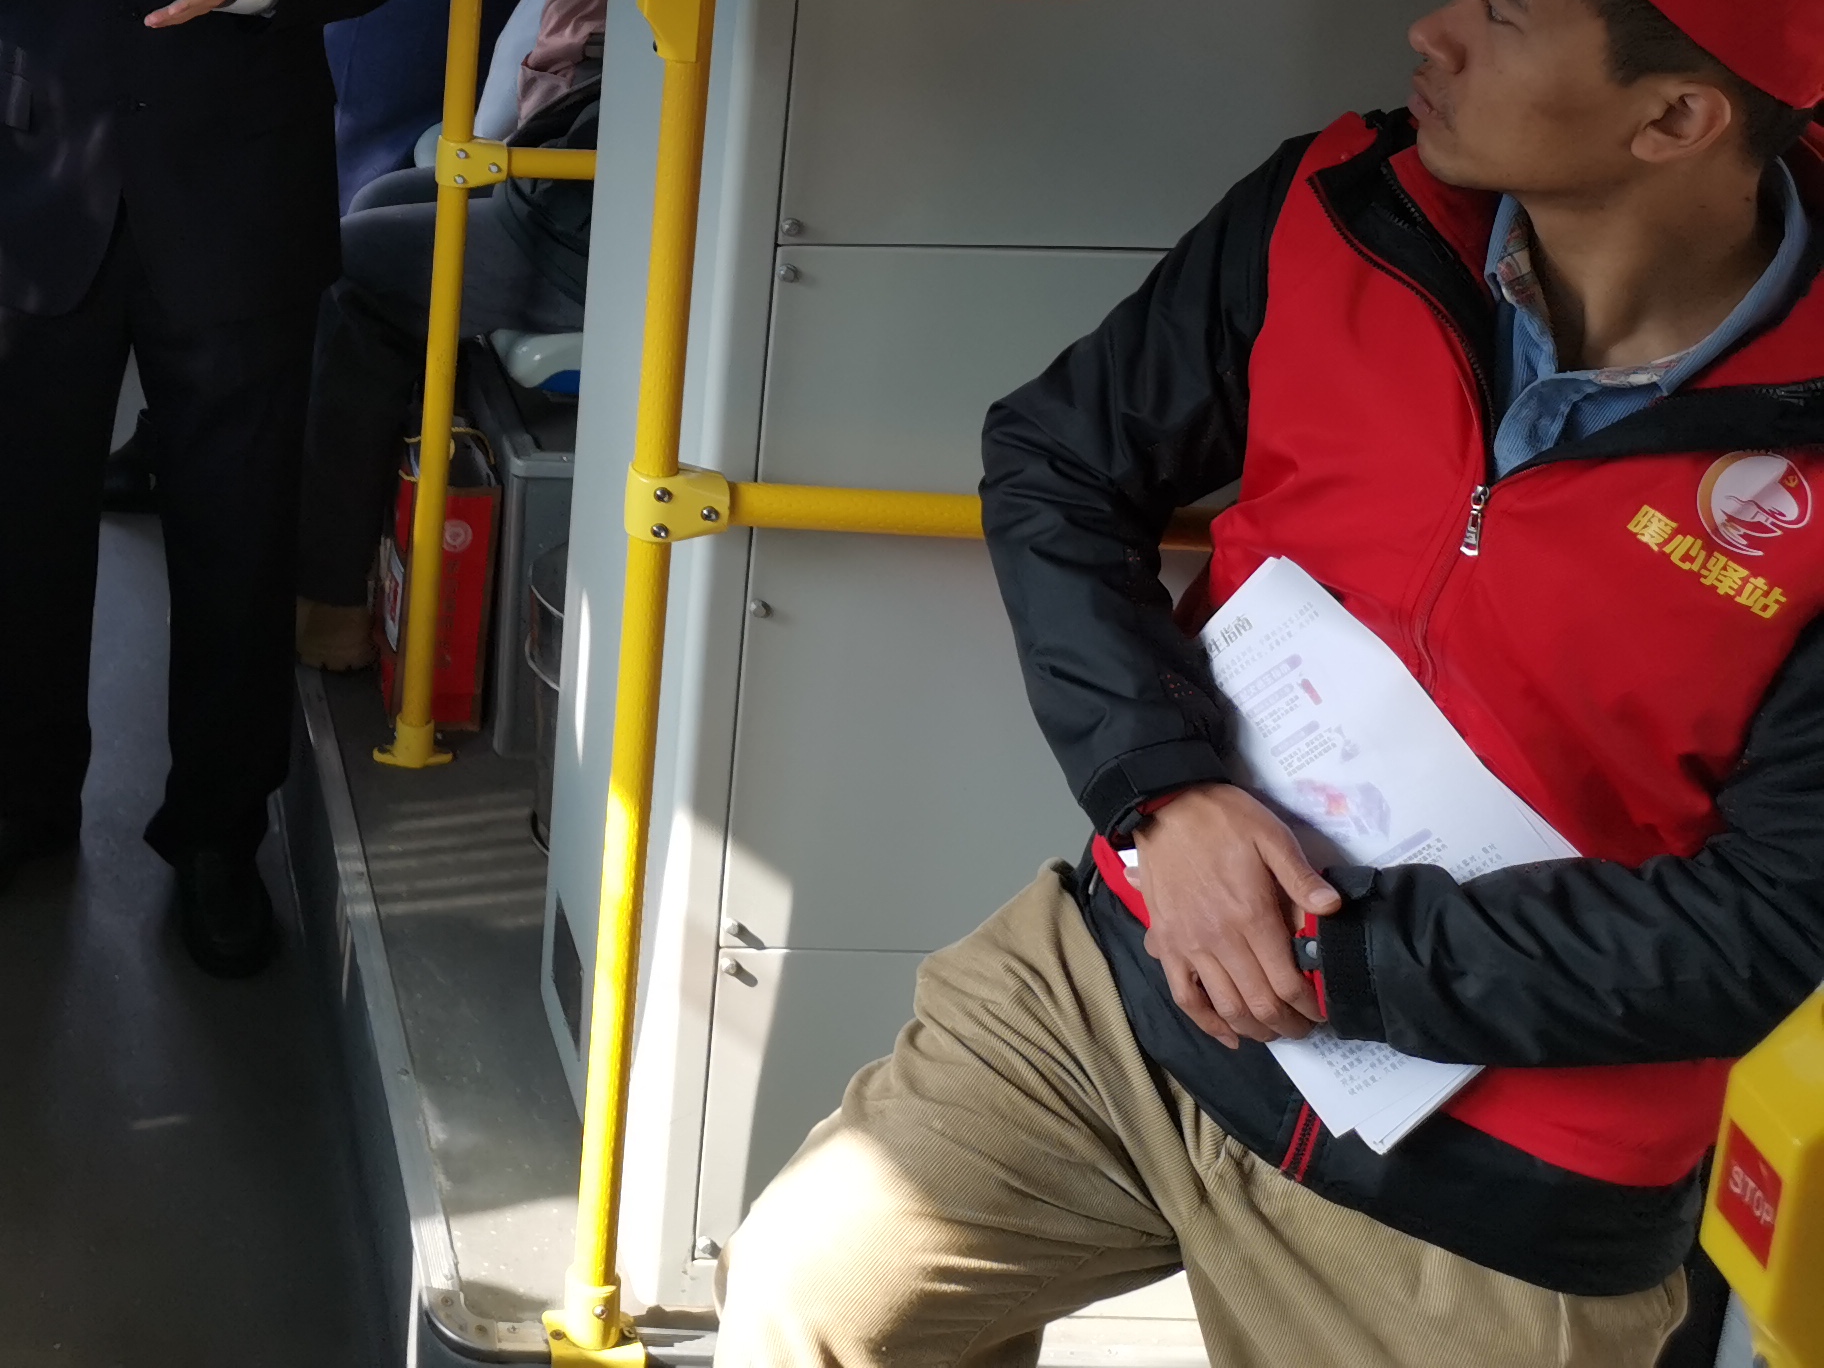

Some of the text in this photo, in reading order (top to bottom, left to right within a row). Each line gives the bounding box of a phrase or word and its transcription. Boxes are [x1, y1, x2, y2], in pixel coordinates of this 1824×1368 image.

[1626, 504, 1787, 619] 暖心驿站
[1729, 1166, 1775, 1225] STOP
